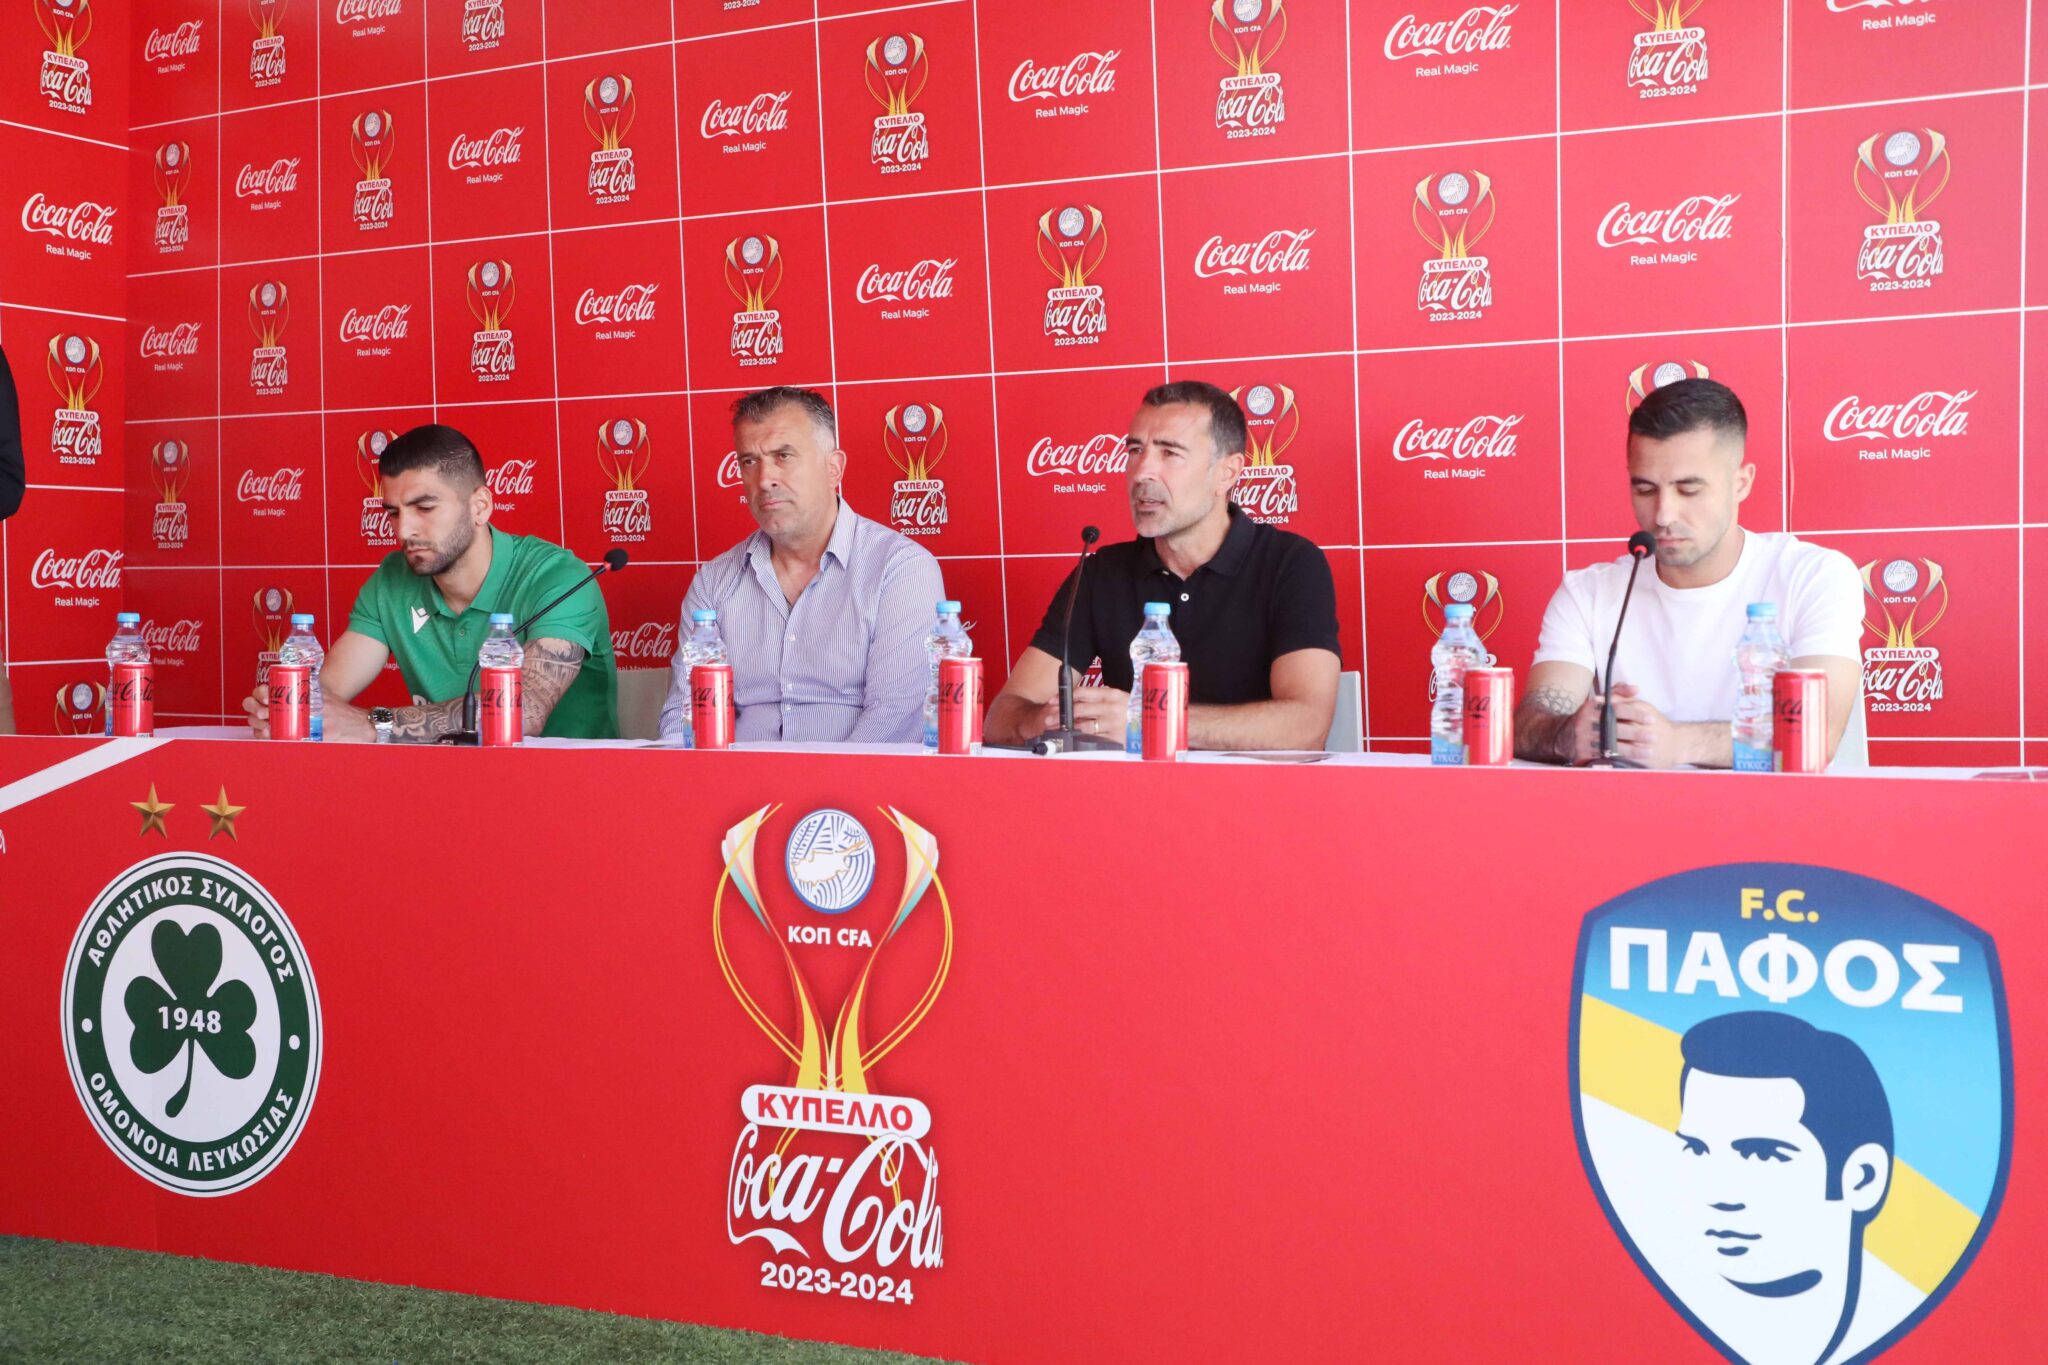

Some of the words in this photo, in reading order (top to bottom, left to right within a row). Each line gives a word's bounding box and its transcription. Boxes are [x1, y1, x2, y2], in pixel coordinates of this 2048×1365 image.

[352, 28, 366, 37] Real
[367, 26, 385, 35] Magic
[1862, 17, 1892, 30] Real
[1895, 12, 1936, 27] Magic
[145, 20, 204, 63] Coca-Cola
[1384, 4, 1519, 60] Coca-Cola
[1638, 29, 1697, 44] ΚΥΠΕΛΛΟ
[47, 53, 85, 69] ΚΥΠΕΛΛΟ
[1416, 66, 1440, 77] Real
[1444, 62, 1478, 74] Magic
[1625, 39, 1707, 88] Coca-Cola
[1008, 50, 1121, 102] Coca-Cola
[1225, 75, 1275, 89] ΚΥΠΕΛΛΟ
[1640, 84, 1696, 98] 2023-2024
[49, 99, 86, 115] 2023-2024
[701, 91, 792, 138] Coca-Cola
[1036, 107, 1056, 118] Real
[1060, 104, 1088, 115] Magic
[1215, 84, 1284, 129] Coca-Cola
[878, 114, 920, 126] ΚΥΠΕΛΛΟ
[1227, 125, 1275, 139] 2023-2024
[448, 127, 524, 170] Coca-Cola
[723, 144, 740, 153] Real
[742, 141, 766, 152] Magic
[870, 122, 928, 164] Coca-Cola
[236, 158, 300, 197] Coca-Cola
[881, 161, 921, 174] 2023-2024
[21, 192, 118, 245] Coca-Cola
[1597, 194, 1741, 247] Coca-Cola
[1870, 222, 1933, 237] ΚΥΠΕΛΛΟ
[45, 244, 65, 256] Real
[67, 247, 92, 260] Magic
[1195, 229, 1316, 278] Coca-Cola
[1631, 254, 1656, 265] Real
[1661, 251, 1697, 264] Magic
[1856, 233, 1943, 281] Coca-Cola
[1428, 257, 1482, 270] ΚΥΠΕΛΛΟ
[857, 259, 957, 303] Coca-Cola
[1224, 284, 1246, 294] Real
[1250, 282, 1281, 293] Magic
[1417, 267, 1492, 311] Coca-Cola
[1870, 278, 1931, 291] 2023-2024
[1051, 287, 1097, 298] ΚΥΠΕΛΛΟ
[575, 284, 658, 325] Coca-Cola
[881, 310, 900, 319] Real
[903, 308, 929, 319] Magic
[1430, 309, 1482, 321] 2023-2024
[340, 304, 411, 342] Coca-Cola
[1043, 296, 1106, 337] Coca-Cola
[140, 323, 201, 357] Coca-Cola
[596, 331, 611, 339] Real
[613, 330, 635, 339] Magic
[1055, 335, 1098, 346] 2023-2024
[740, 357, 776, 366] 2023-2024
[59, 411, 95, 421] ΚΥΠΕΛΛΟ
[1824, 390, 1977, 441] Coca-Cola
[1393, 415, 1524, 461] Coca-Cola
[1026, 434, 1129, 477] Coca-Cola
[1859, 449, 1886, 460] Real
[1892, 448, 1930, 460] Magic
[485, 459, 537, 495] a-Cola
[1424, 469, 1447, 478] Real
[1452, 468, 1485, 479] Magic
[237, 468, 304, 501] Coca-Cola
[897, 480, 939, 490] ΚΥΠΕΛΛΟ
[1054, 484, 1073, 493] Real
[1077, 483, 1105, 493] Magic
[495, 502, 515, 511] Magic
[890, 489, 947, 526] Coca-Cola
[1253, 516, 1289, 524] 23-2024
[898, 527, 940, 535] 2023-2024
[31, 548, 124, 589] Coca-Cola
[55, 597, 73, 606] Real
[75, 597, 100, 608] Magic
[611, 622, 676, 658] ca-Cola
[1870, 649, 1932, 659] ΚΥΠΕΛΛΟ
[1872, 703, 1931, 711] 2023-2024
[1740, 887, 1820, 924] F.C.
[87, 876, 194, 968] ΑΘΛΗΤΙΚΟΣ
[200, 877, 294, 983] ΣΥΛΛΟΓΟΣ
[788, 925, 833, 946] ΚΟΠ
[837, 928, 873, 949] CFA
[1609, 925, 1964, 1014] ΠΑΦΟΣ
[157, 1005, 222, 1034] 1948
[90, 1072, 179, 1168] ΟΜΟΝΟΙΑ
[188, 1088, 293, 1172] ΛΕΥΚΩΣΙΑΣ
[757, 1092, 914, 1132] ΚΥΠΕΛΛΟ
[726, 1122, 944, 1269] Coca-Cola
[760, 1260, 914, 1306] 2023-2024
